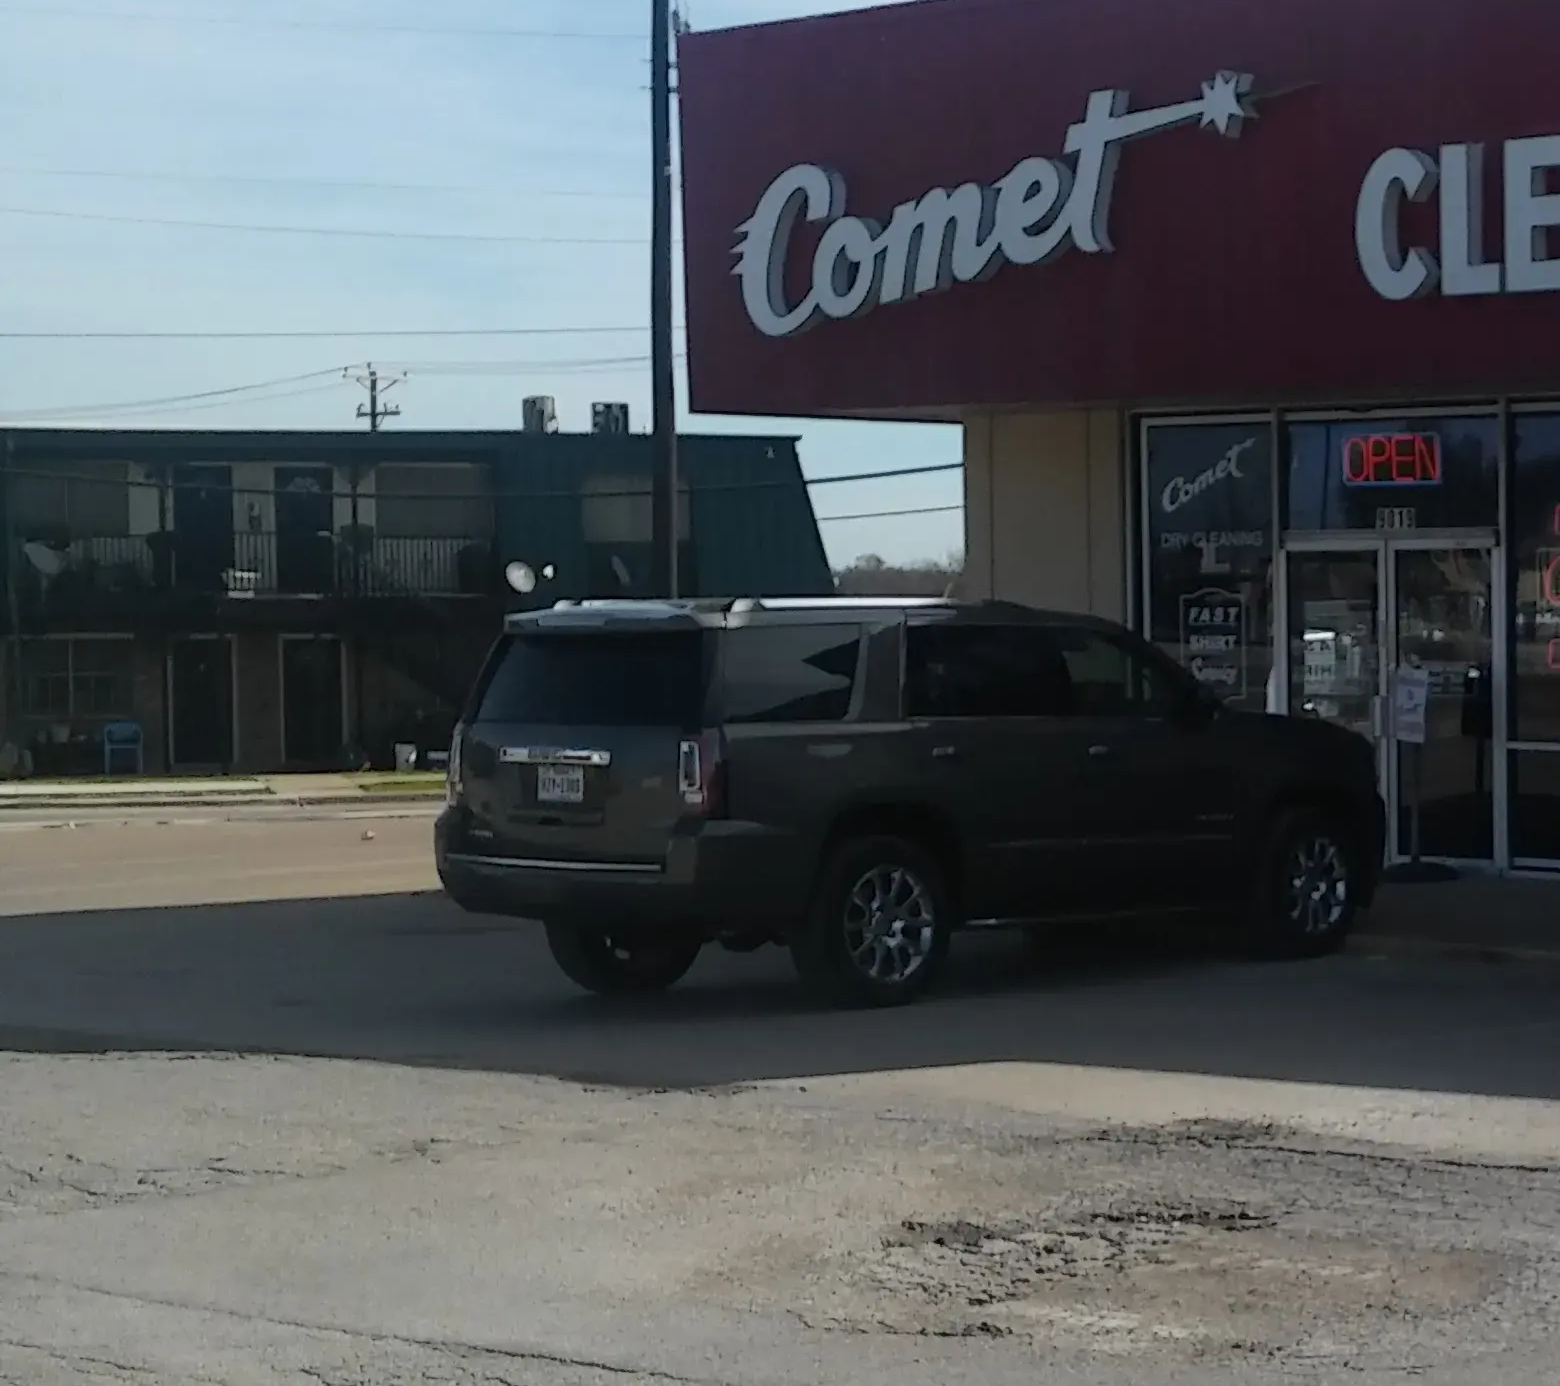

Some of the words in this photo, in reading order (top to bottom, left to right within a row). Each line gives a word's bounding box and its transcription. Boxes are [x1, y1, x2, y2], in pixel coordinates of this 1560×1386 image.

[730, 71, 1250, 338] Comet
[1161, 437, 1257, 513] Comet
[1344, 434, 1440, 482] OPEN
[1187, 606, 1241, 625] FAST
